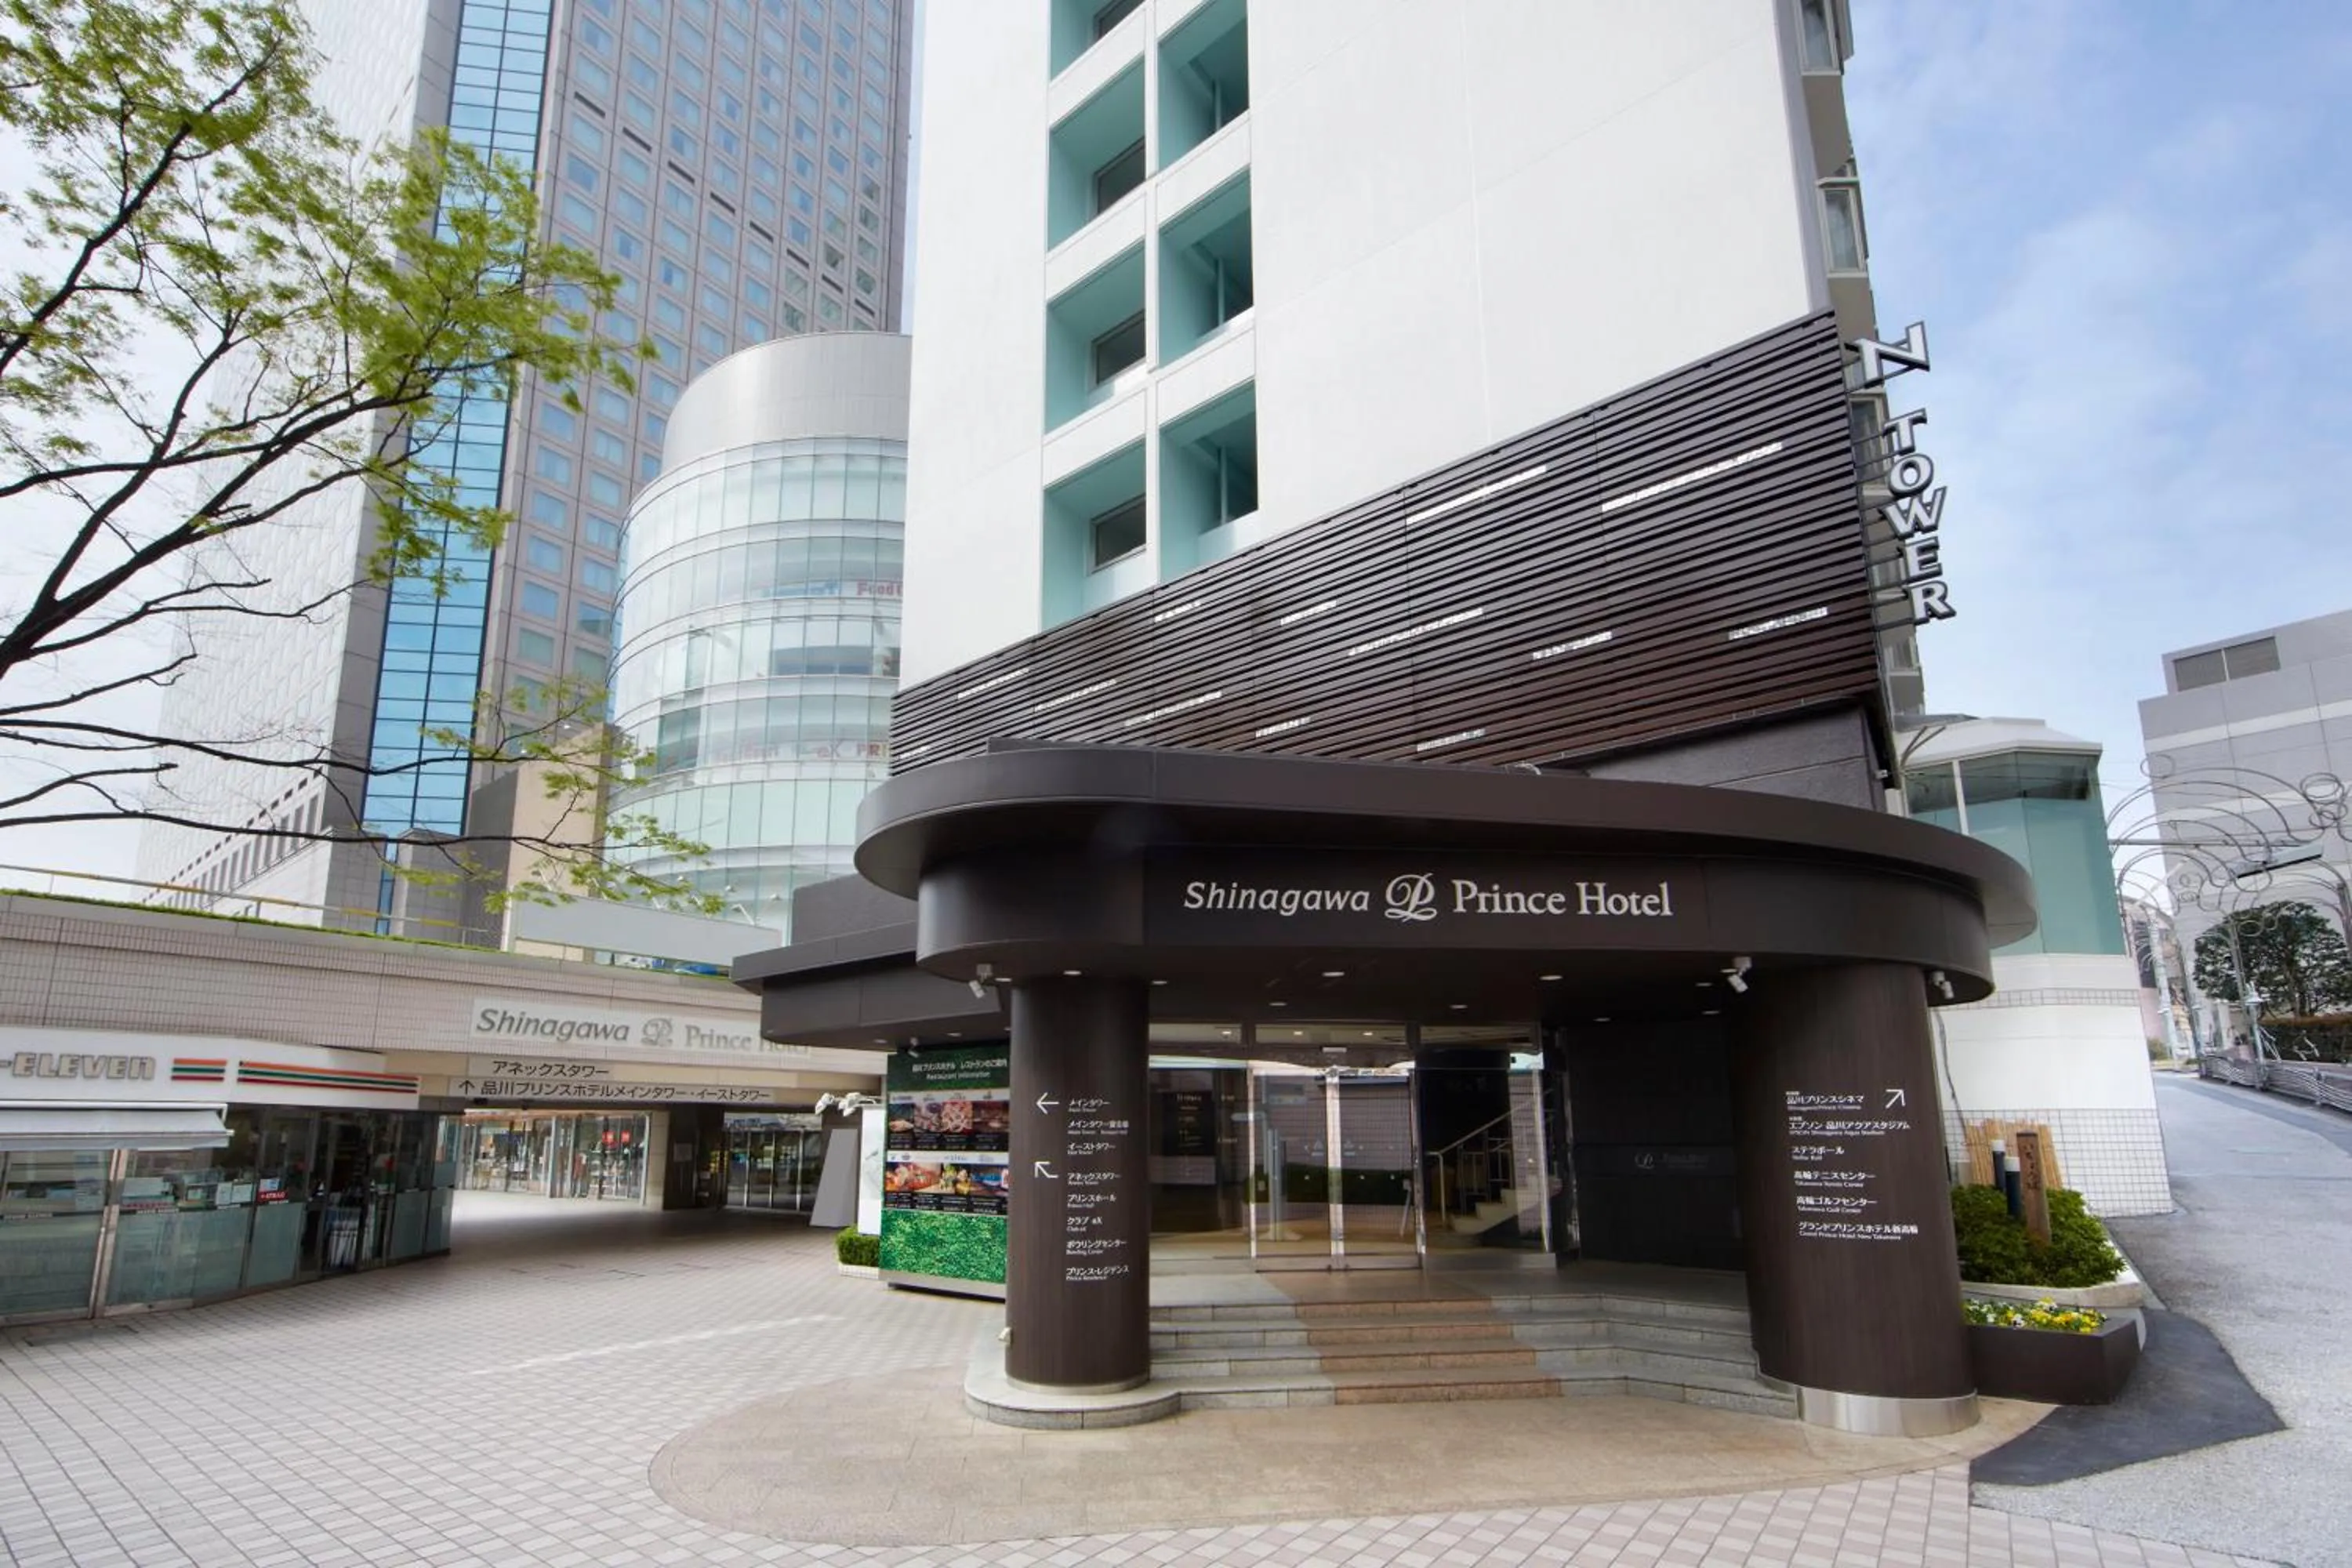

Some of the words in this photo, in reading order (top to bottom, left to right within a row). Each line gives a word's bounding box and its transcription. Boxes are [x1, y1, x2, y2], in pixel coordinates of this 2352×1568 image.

[1854, 321, 1930, 389] N
[1882, 408, 1956, 626] TOWER
[1184, 881, 1370, 916] Shinagawa
[1452, 879, 1567, 915] Prince
[1576, 880, 1674, 916] Hotel
[477, 1008, 630, 1043] Shinagawa
[684, 1024, 752, 1051] Prince
[493, 1060, 610, 1079] アネックスタワー
